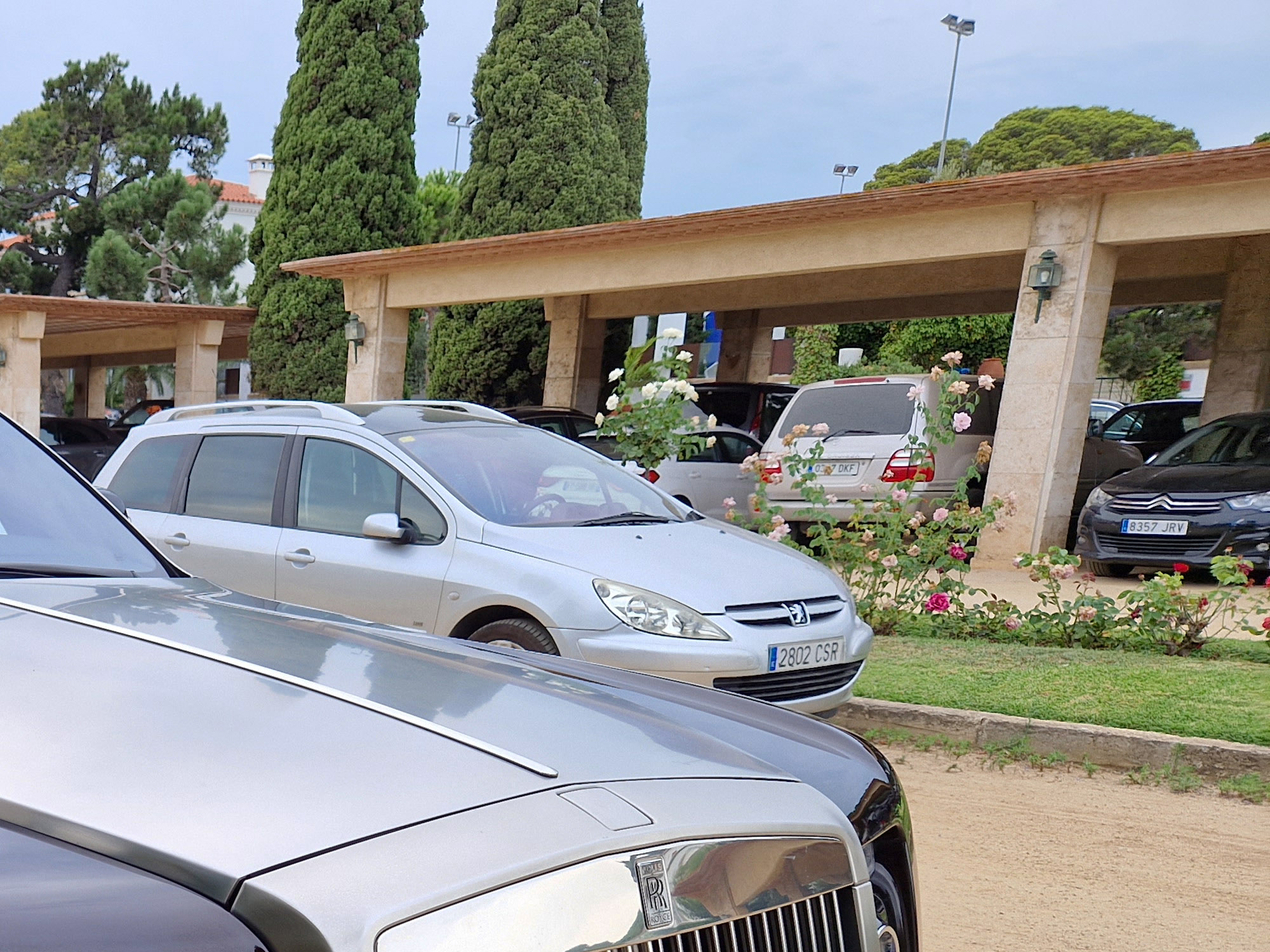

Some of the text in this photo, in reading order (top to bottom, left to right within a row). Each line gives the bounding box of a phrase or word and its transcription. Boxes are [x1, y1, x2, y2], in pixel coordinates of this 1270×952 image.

[838, 463, 855, 473] DKF
[1129, 521, 1184, 533] 8357 JRV
[779, 642, 839, 668] 2802 CSR
